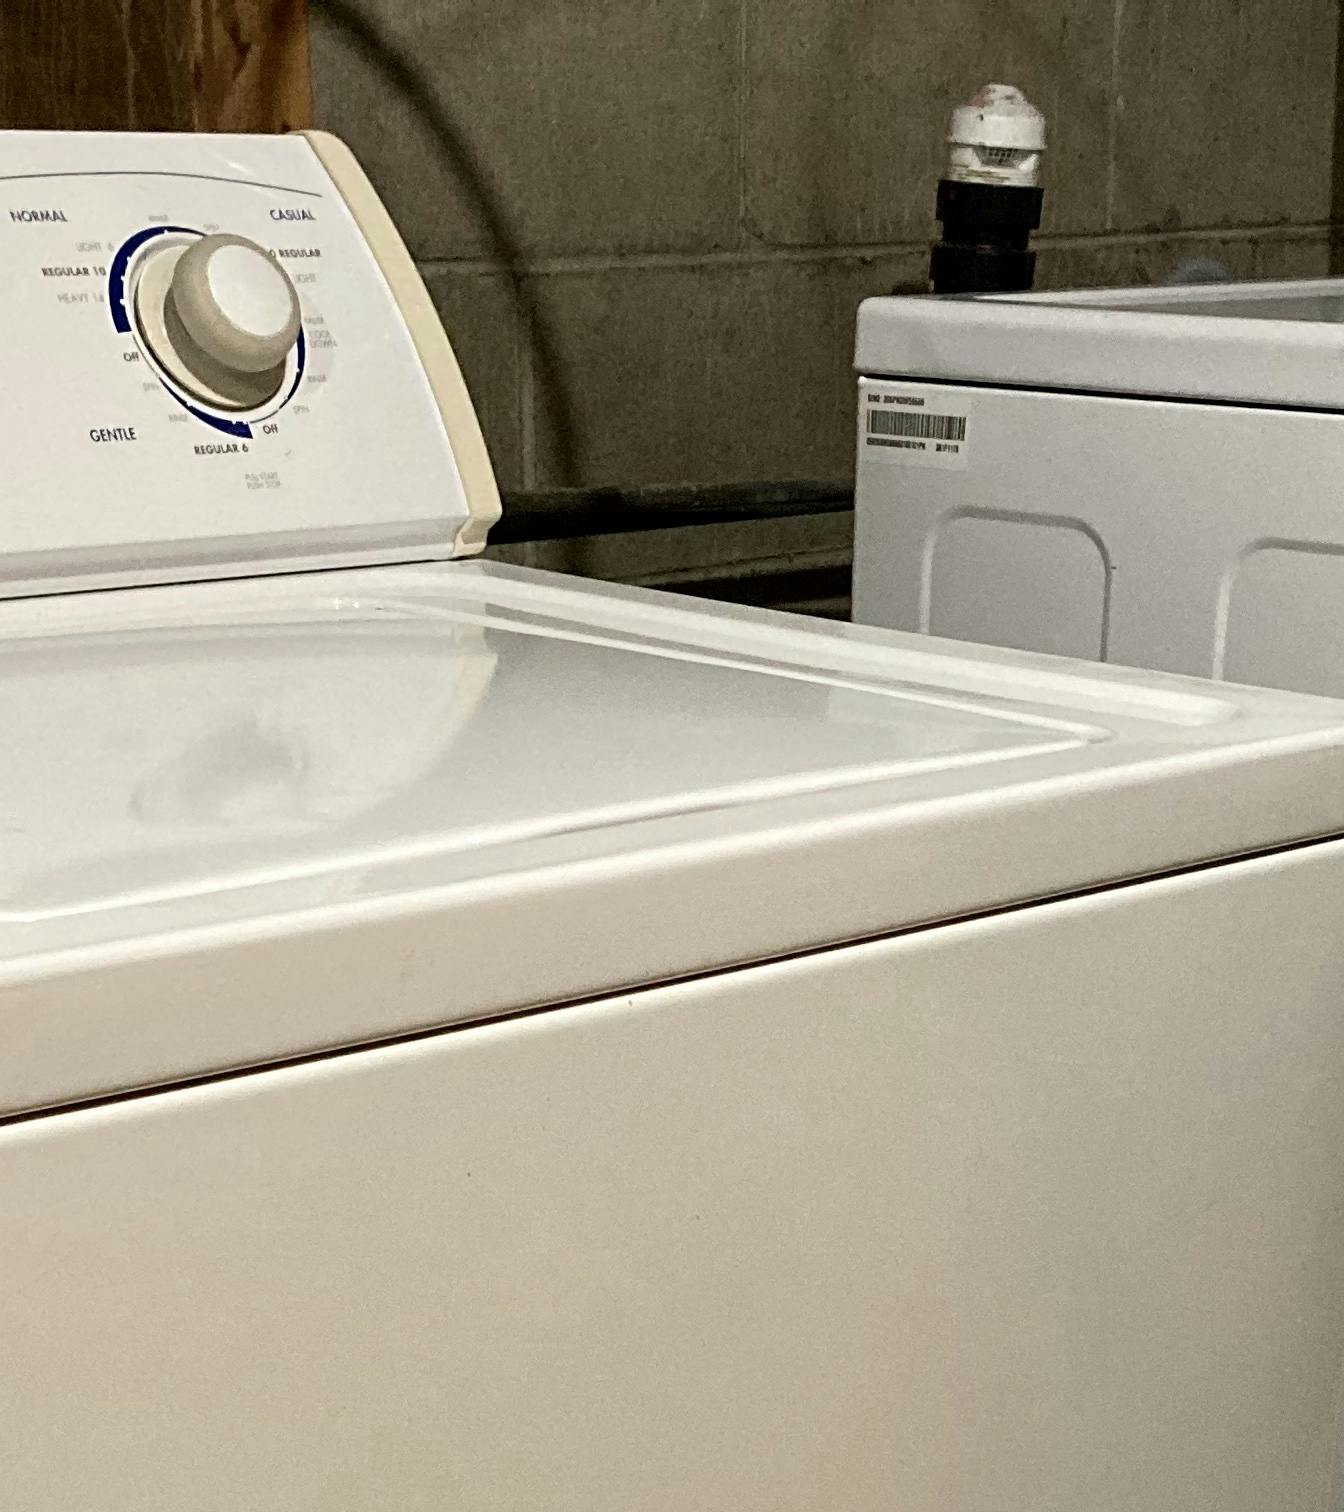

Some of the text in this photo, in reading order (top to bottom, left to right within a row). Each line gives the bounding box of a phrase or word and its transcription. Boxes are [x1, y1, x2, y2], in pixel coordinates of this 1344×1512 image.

[9, 209, 68, 222] NORMAL
[269, 209, 316, 221] CASUAL
[279, 248, 322, 258] REGULAR
[41, 266, 106, 277] REGULAR 10
[123, 352, 140, 362] Off
[89, 427, 137, 442] GENTLE
[263, 424, 279, 434] Off
[194, 443, 250, 455] REGULAR 6
